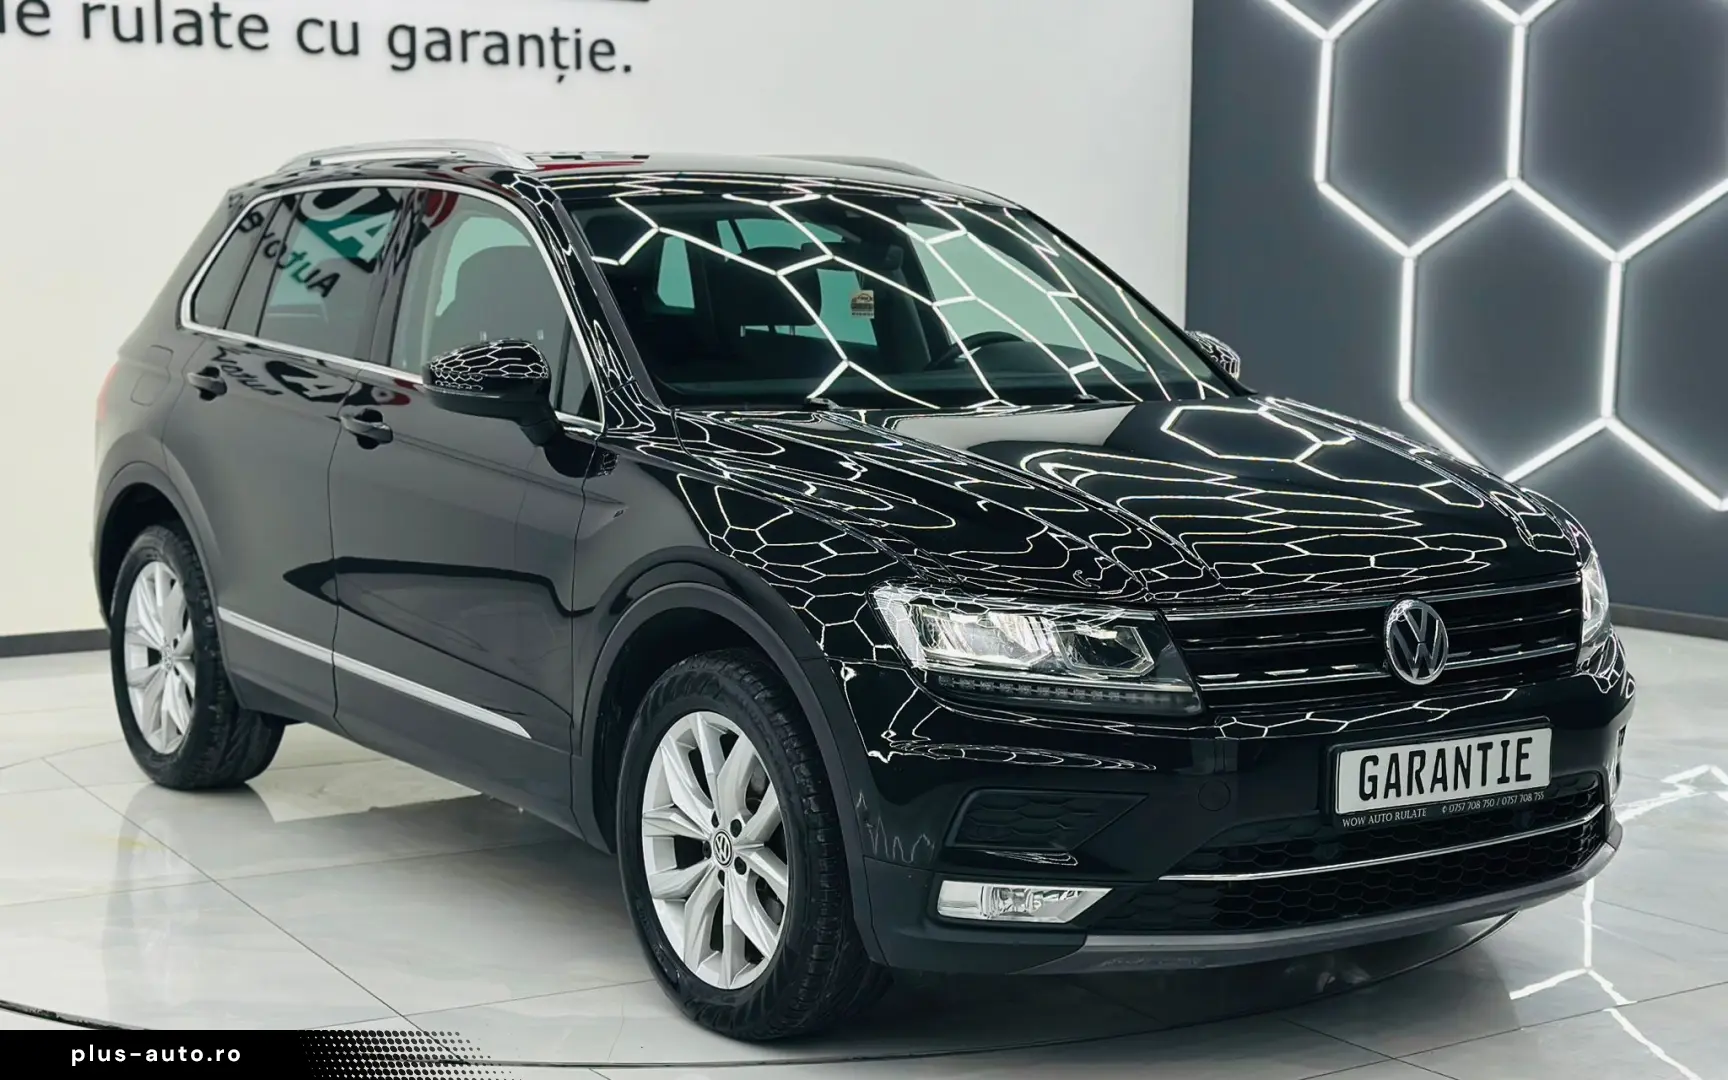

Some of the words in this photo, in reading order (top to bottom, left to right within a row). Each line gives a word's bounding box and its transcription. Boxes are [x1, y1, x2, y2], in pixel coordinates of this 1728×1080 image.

[82, 0, 269, 51] rulate
[296, 17, 360, 57] cu
[387, 24, 632, 84] garanție.
[1387, 600, 1448, 684] VW
[1358, 736, 1533, 801] GARANTIE
[1342, 816, 1366, 828] WOW
[1368, 812, 1393, 825] AUTO
[1394, 807, 1428, 821] RULATE
[1448, 802, 1465, 813] 0757
[1467, 800, 1481, 810] 708
[1501, 795, 1518, 806] 0757
[1519, 793, 1532, 803] 708
[1534, 791, 1545, 800] 755
